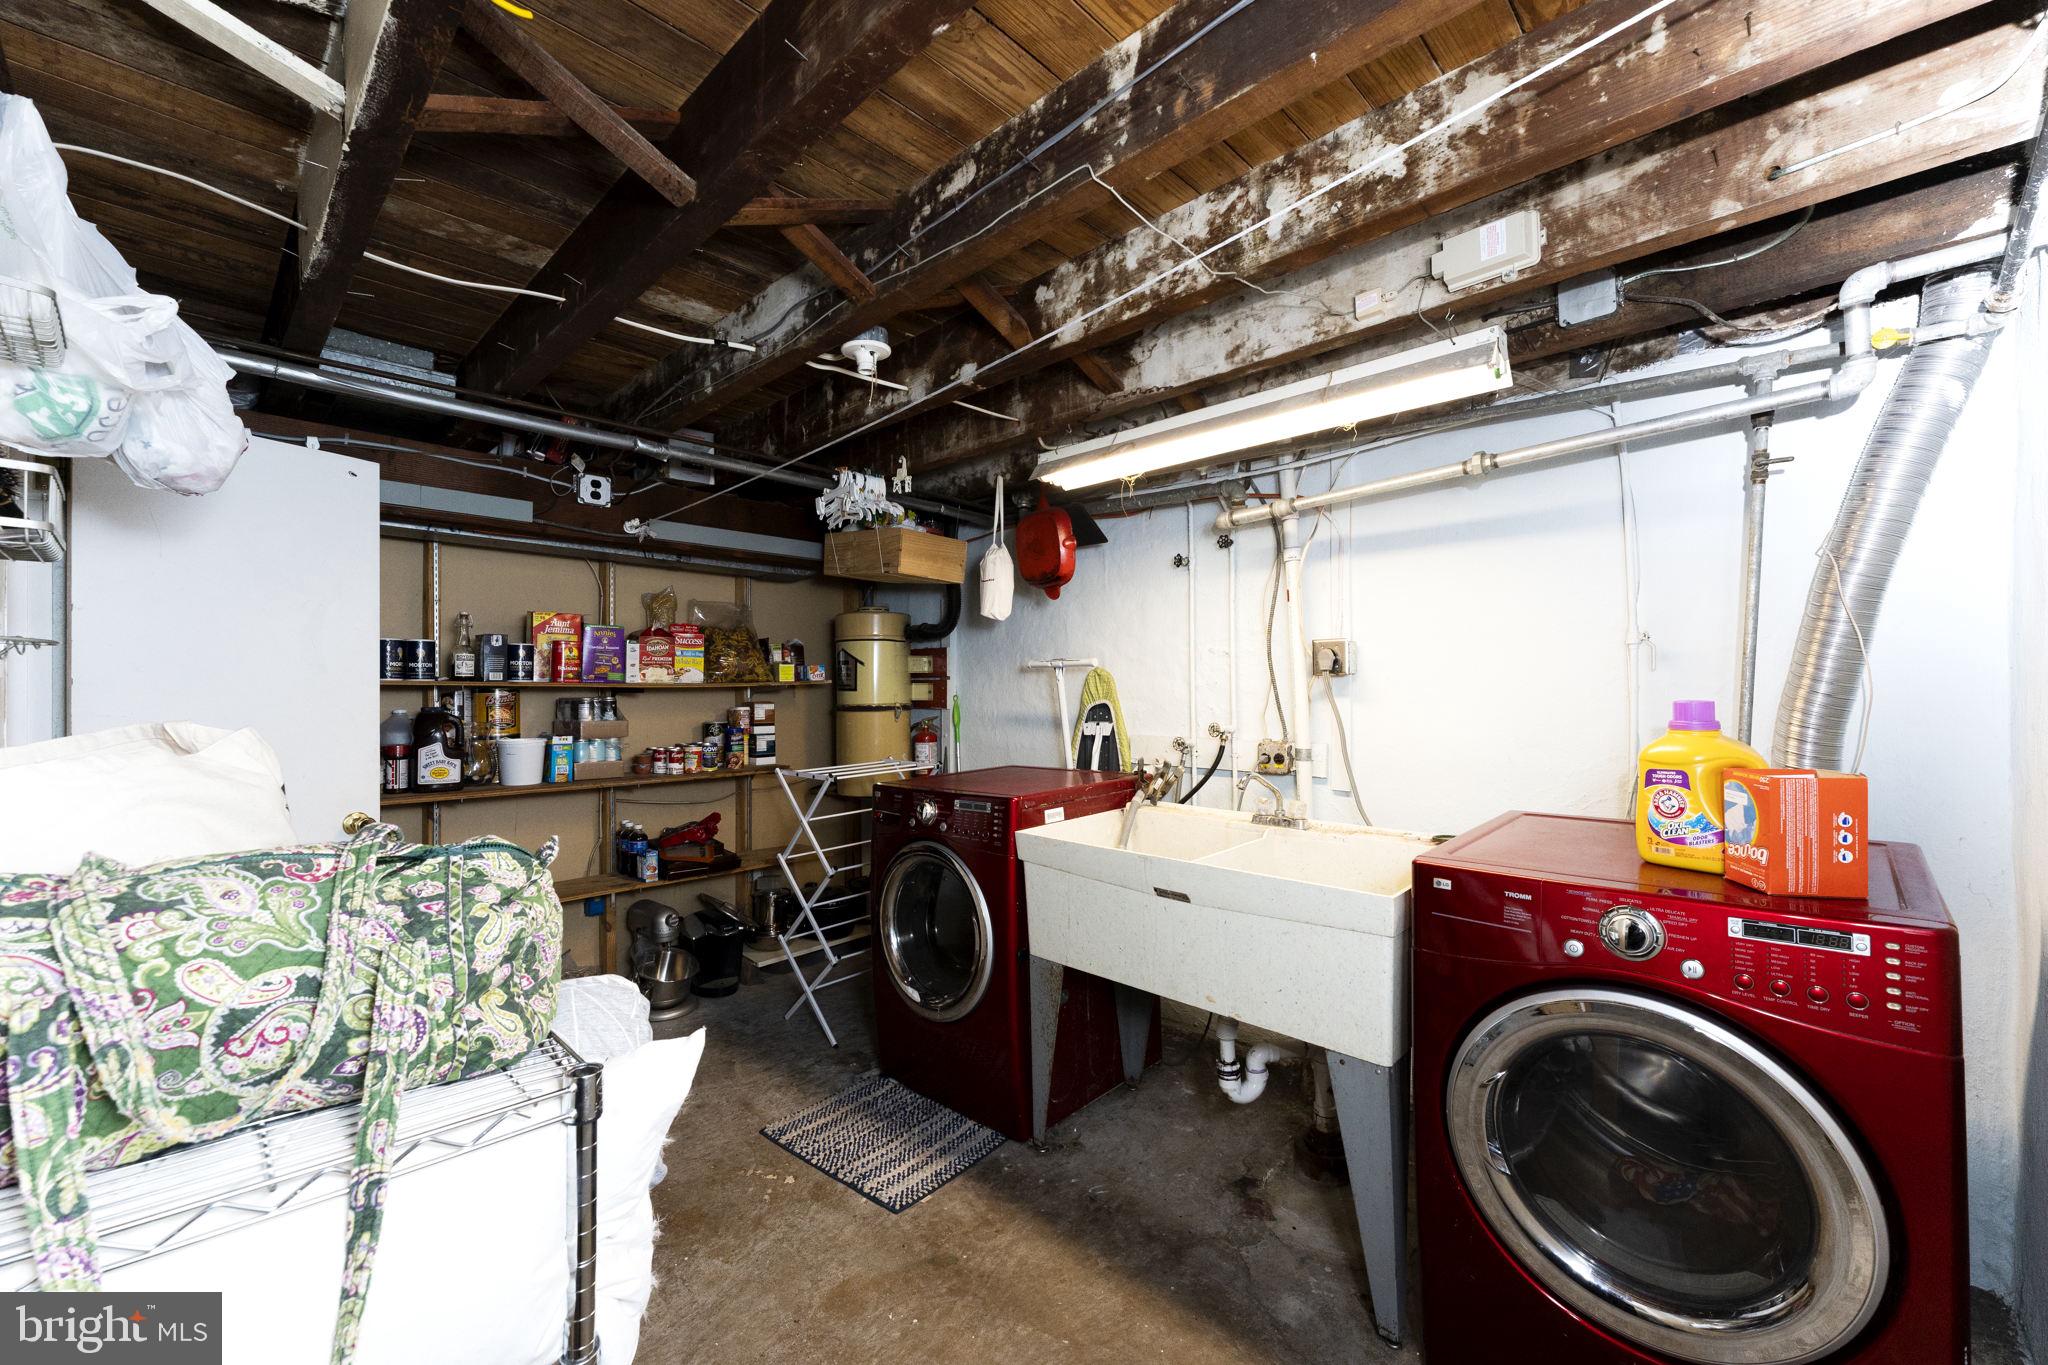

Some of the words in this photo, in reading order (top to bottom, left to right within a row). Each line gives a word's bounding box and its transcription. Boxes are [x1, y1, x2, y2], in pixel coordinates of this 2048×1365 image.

[551, 618, 571, 627] Aunt
[541, 625, 575, 634] Jemima
[675, 636, 703, 645] Success
[1662, 827, 1690, 837] CLEAN
[1728, 843, 1769, 865] bounce
[1504, 890, 1532, 901] TROMM
[1776, 999, 1800, 1007] CONTROL
[1848, 1012, 1869, 1020] BEEPER
